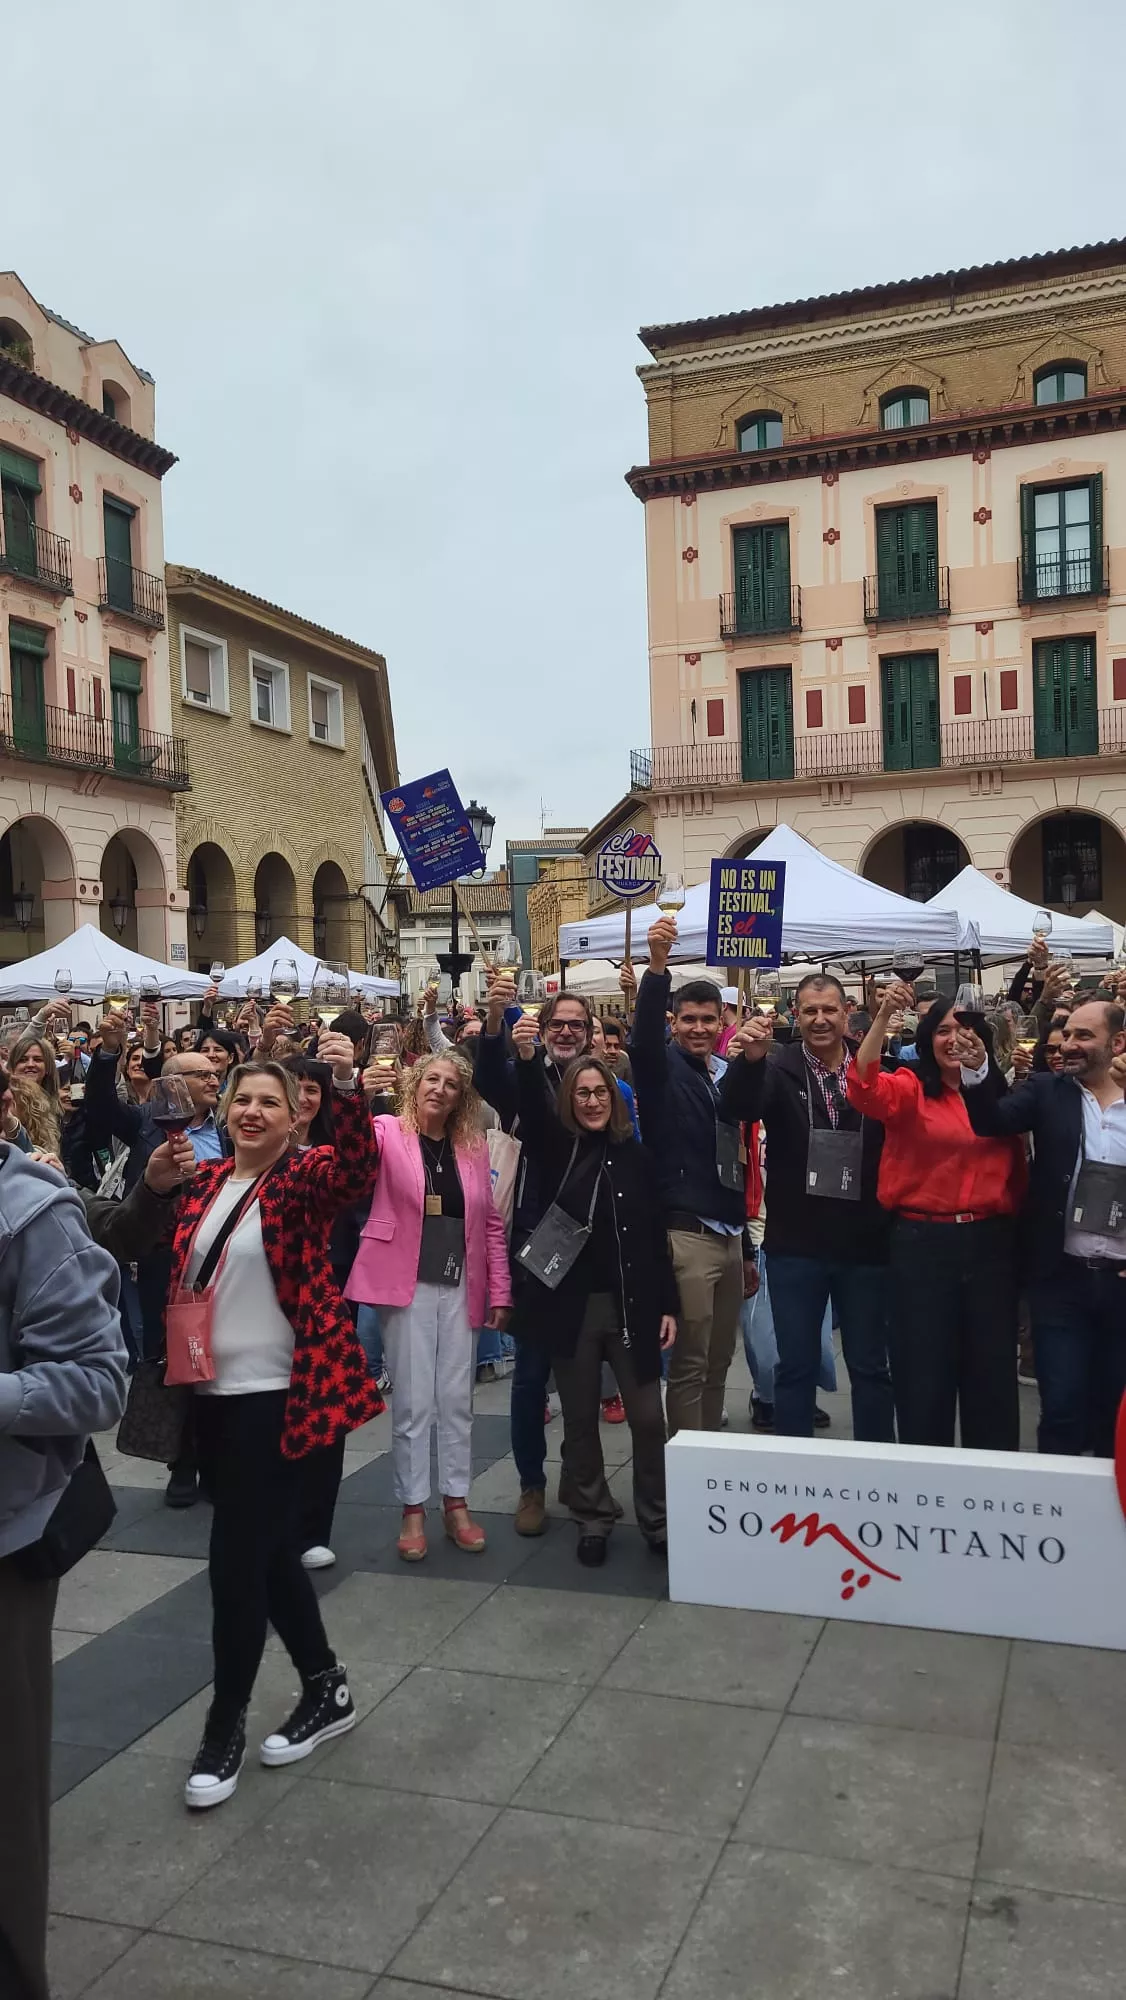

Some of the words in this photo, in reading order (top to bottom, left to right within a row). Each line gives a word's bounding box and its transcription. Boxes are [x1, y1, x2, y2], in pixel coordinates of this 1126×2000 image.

[610, 829, 632, 851] el
[624, 835, 651, 857] 21
[598, 854, 660, 881] FESTIVAL
[720, 868, 737, 889] NO
[741, 869, 756, 890] ES
[760, 870, 776, 891] UN
[719, 891, 775, 916] FESTIVAL,
[717, 914, 733, 935] ES
[734, 914, 756, 934] el
[716, 936, 773, 958] FESTIVAL.
[707, 1478, 898, 1504] DENOMINACIÓN
[916, 1494, 946, 1508] DE
[963, 1498, 1063, 1517] ORIGEN
